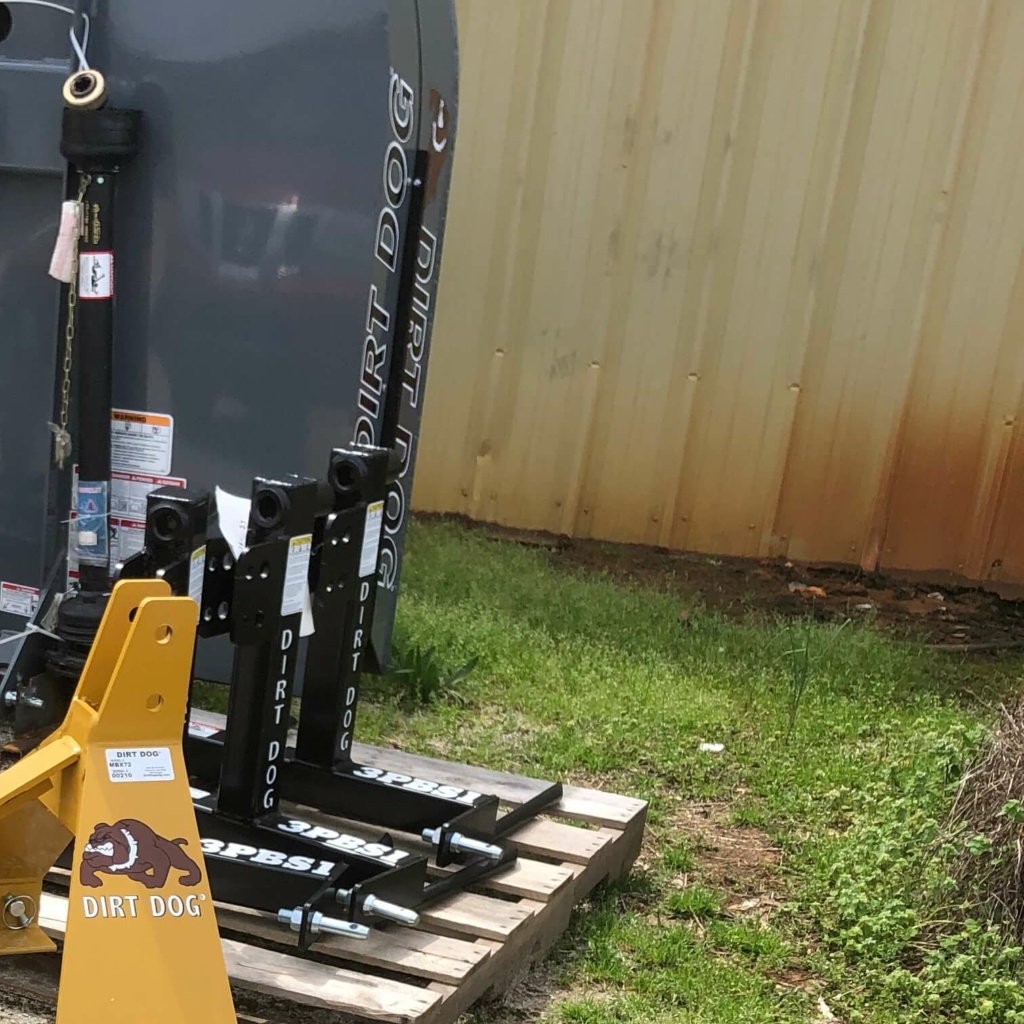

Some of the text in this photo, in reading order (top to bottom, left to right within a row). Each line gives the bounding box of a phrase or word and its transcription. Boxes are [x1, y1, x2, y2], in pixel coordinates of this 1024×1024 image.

[354, 73, 414, 449] DIRT DOG
[340, 582, 369, 751] DIRT DOG
[263, 629, 293, 809] DIRT DOG
[352, 766, 483, 804] 3PBS1
[199, 838, 336, 876] 3PBS1
[277, 820, 410, 865] 3PBS1
[82, 894, 202, 918] DIRT DOG
